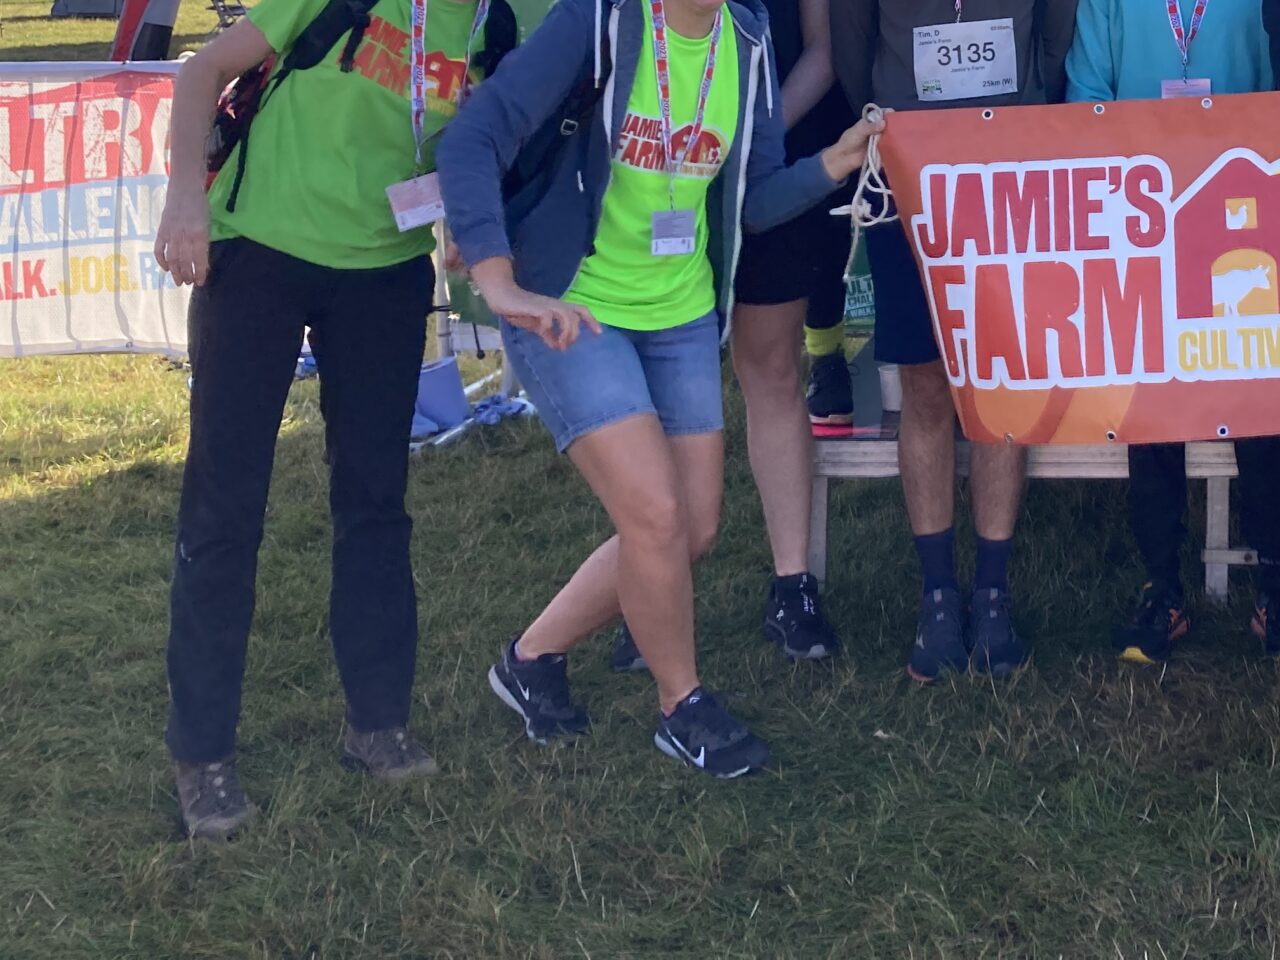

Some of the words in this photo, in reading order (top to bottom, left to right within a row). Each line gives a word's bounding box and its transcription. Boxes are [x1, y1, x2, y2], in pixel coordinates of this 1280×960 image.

[936, 41, 996, 66] 3135
[914, 162, 1165, 259] JAMIE'S
[928, 255, 1165, 382] FARM
